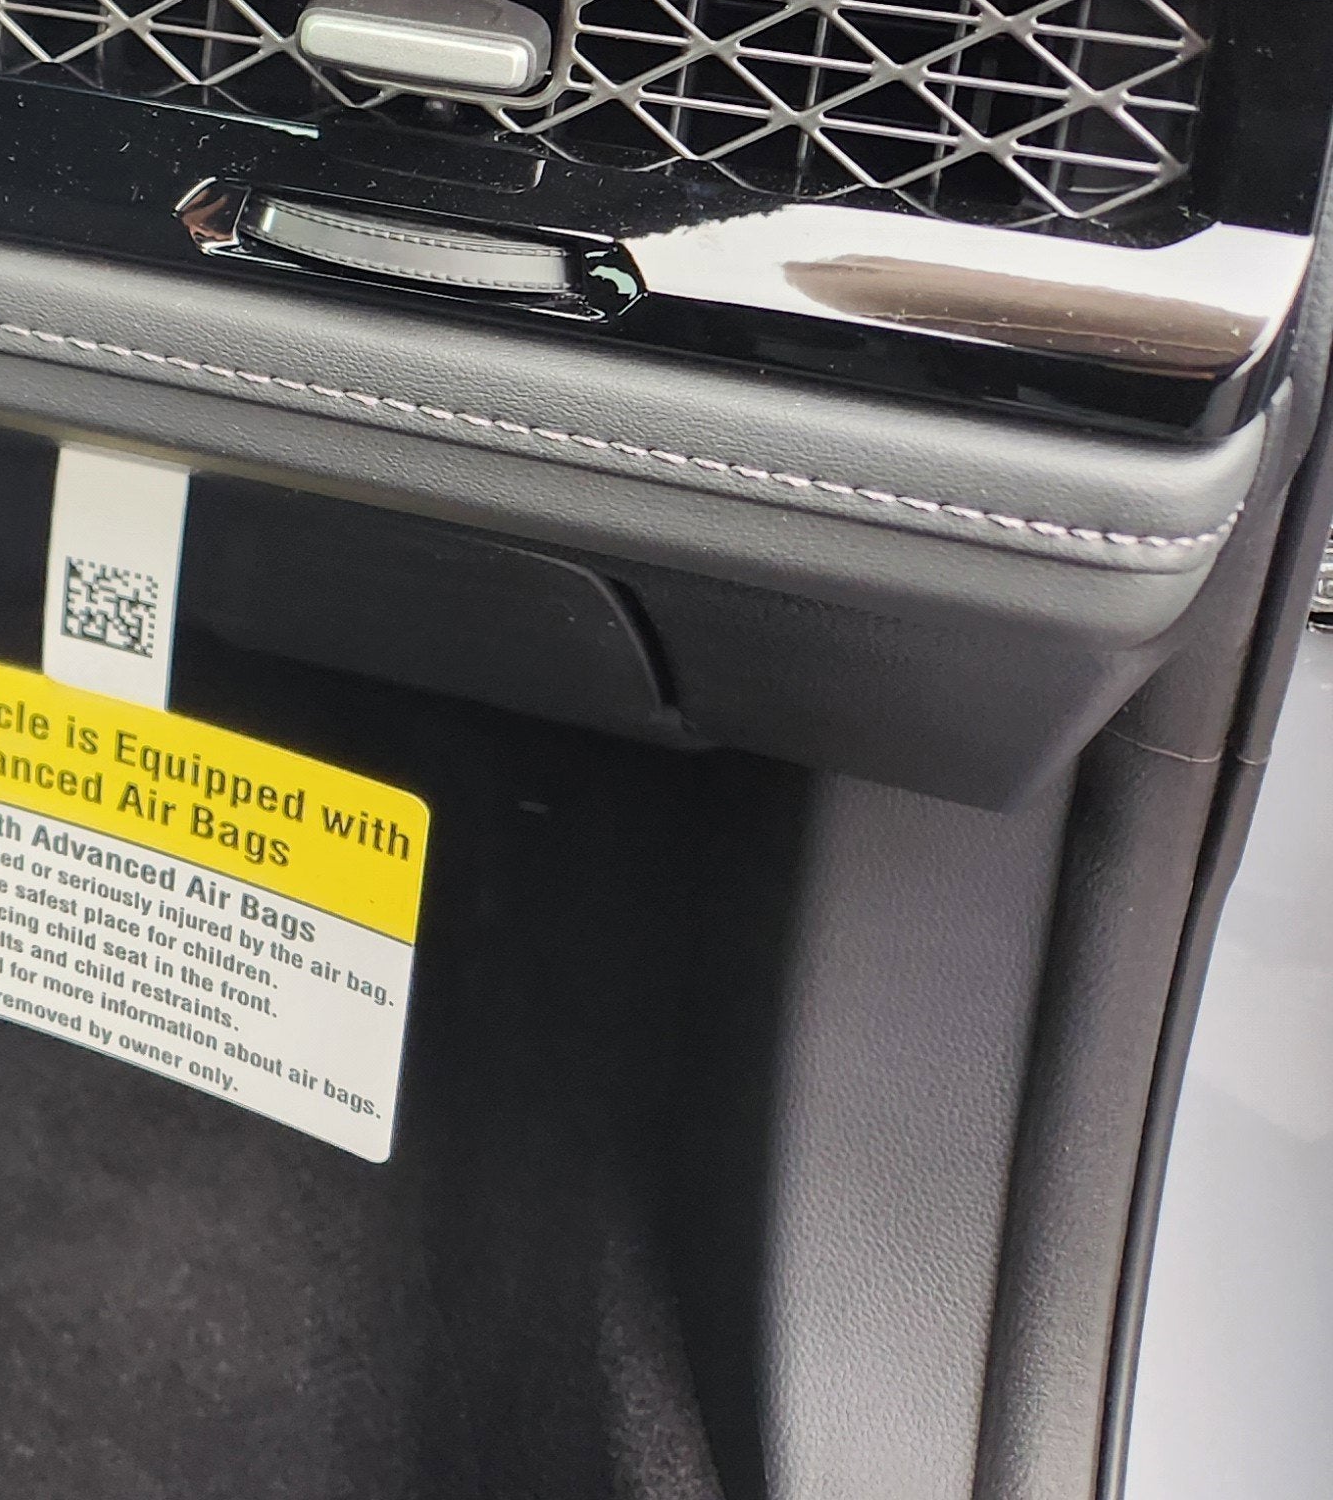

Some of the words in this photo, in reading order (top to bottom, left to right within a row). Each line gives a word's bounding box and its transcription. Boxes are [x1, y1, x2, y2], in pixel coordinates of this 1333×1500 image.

[66, 715, 99, 755] is
[116, 730, 305, 823] Equipped
[322, 805, 410, 861] with
[117, 782, 177, 826] Air
[190, 803, 290, 867] Bags
[31, 824, 176, 892] Advanced
[185, 875, 231, 910] Air
[240, 892, 316, 943] Bags
[31, 862, 53, 880] or
[58, 870, 153, 916] seriously
[158, 899, 233, 943] injured
[239, 928, 265, 957] by
[270, 941, 304, 969] the
[310, 960, 342, 984] air
[346, 970, 394, 1007] bag.
[15, 884, 78, 917] safest
[83, 906, 140, 938] place
[147, 925, 178, 950] for
[183, 941, 278, 990] children.
[30, 944, 68, 969] and
[74, 959, 125, 988] child
[131, 979, 239, 1032] restraints.
[46, 922, 97, 951] child
[103, 941, 148, 969] seat
[154, 955, 174, 979] in
[180, 965, 214, 993] the
[220, 980, 277, 1018] front.
[10, 961, 38, 984] for
[42, 975, 94, 1005] more
[100, 991, 218, 1051] information
[223, 1041, 283, 1078] about
[288, 1067, 319, 1090] air
[323, 1078, 381, 1119] bags.
[88, 1019, 113, 1046] by
[118, 1034, 183, 1069] owner
[188, 1060, 238, 1092] only.
